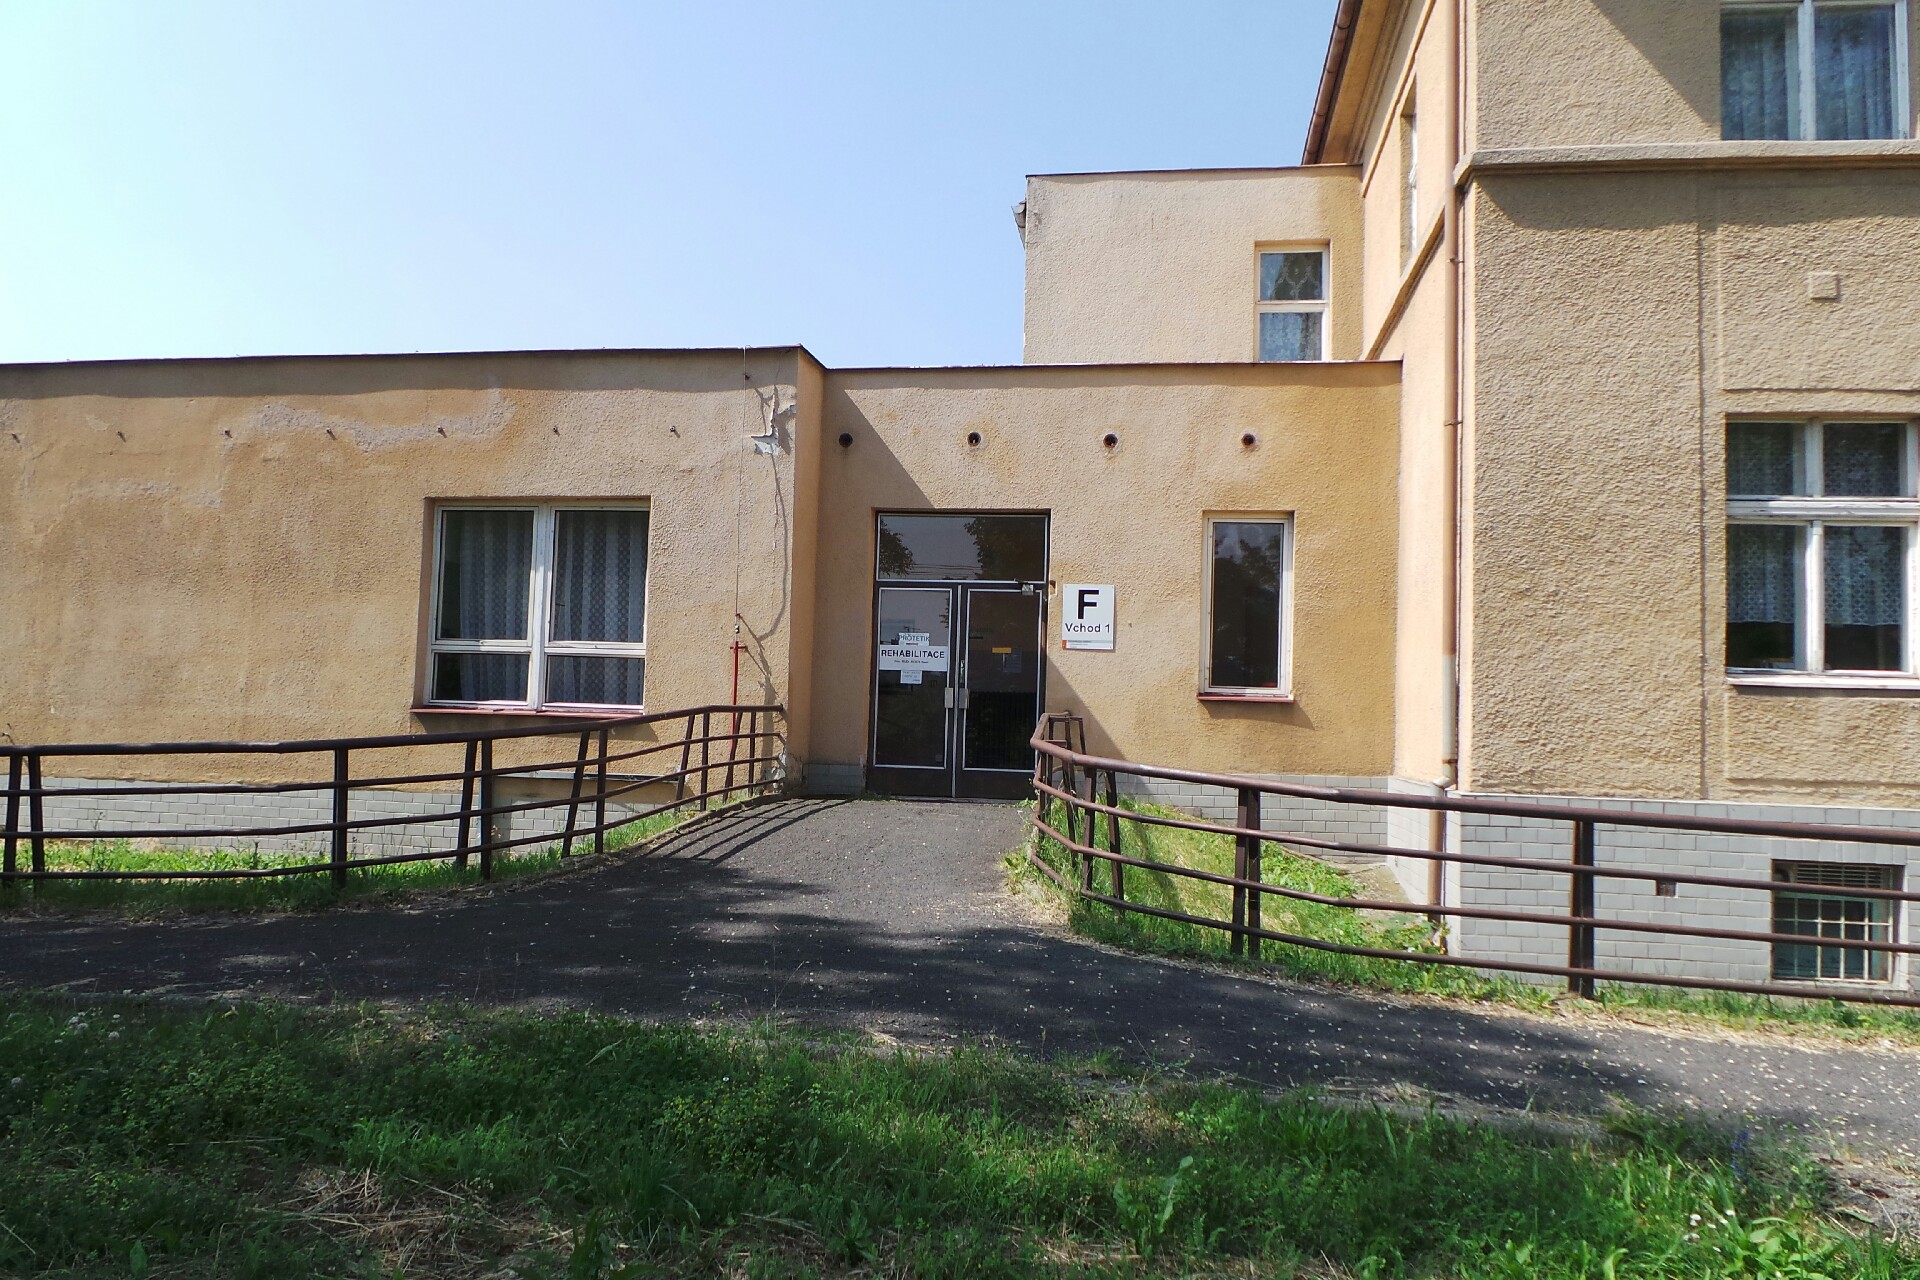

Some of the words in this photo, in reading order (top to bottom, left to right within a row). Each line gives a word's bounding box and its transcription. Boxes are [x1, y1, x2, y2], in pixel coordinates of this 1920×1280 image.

[1078, 589, 1099, 619] F
[1065, 623, 1100, 633] Vchod
[1105, 623, 1110, 633] 1
[881, 649, 945, 659] REHABILITACE
